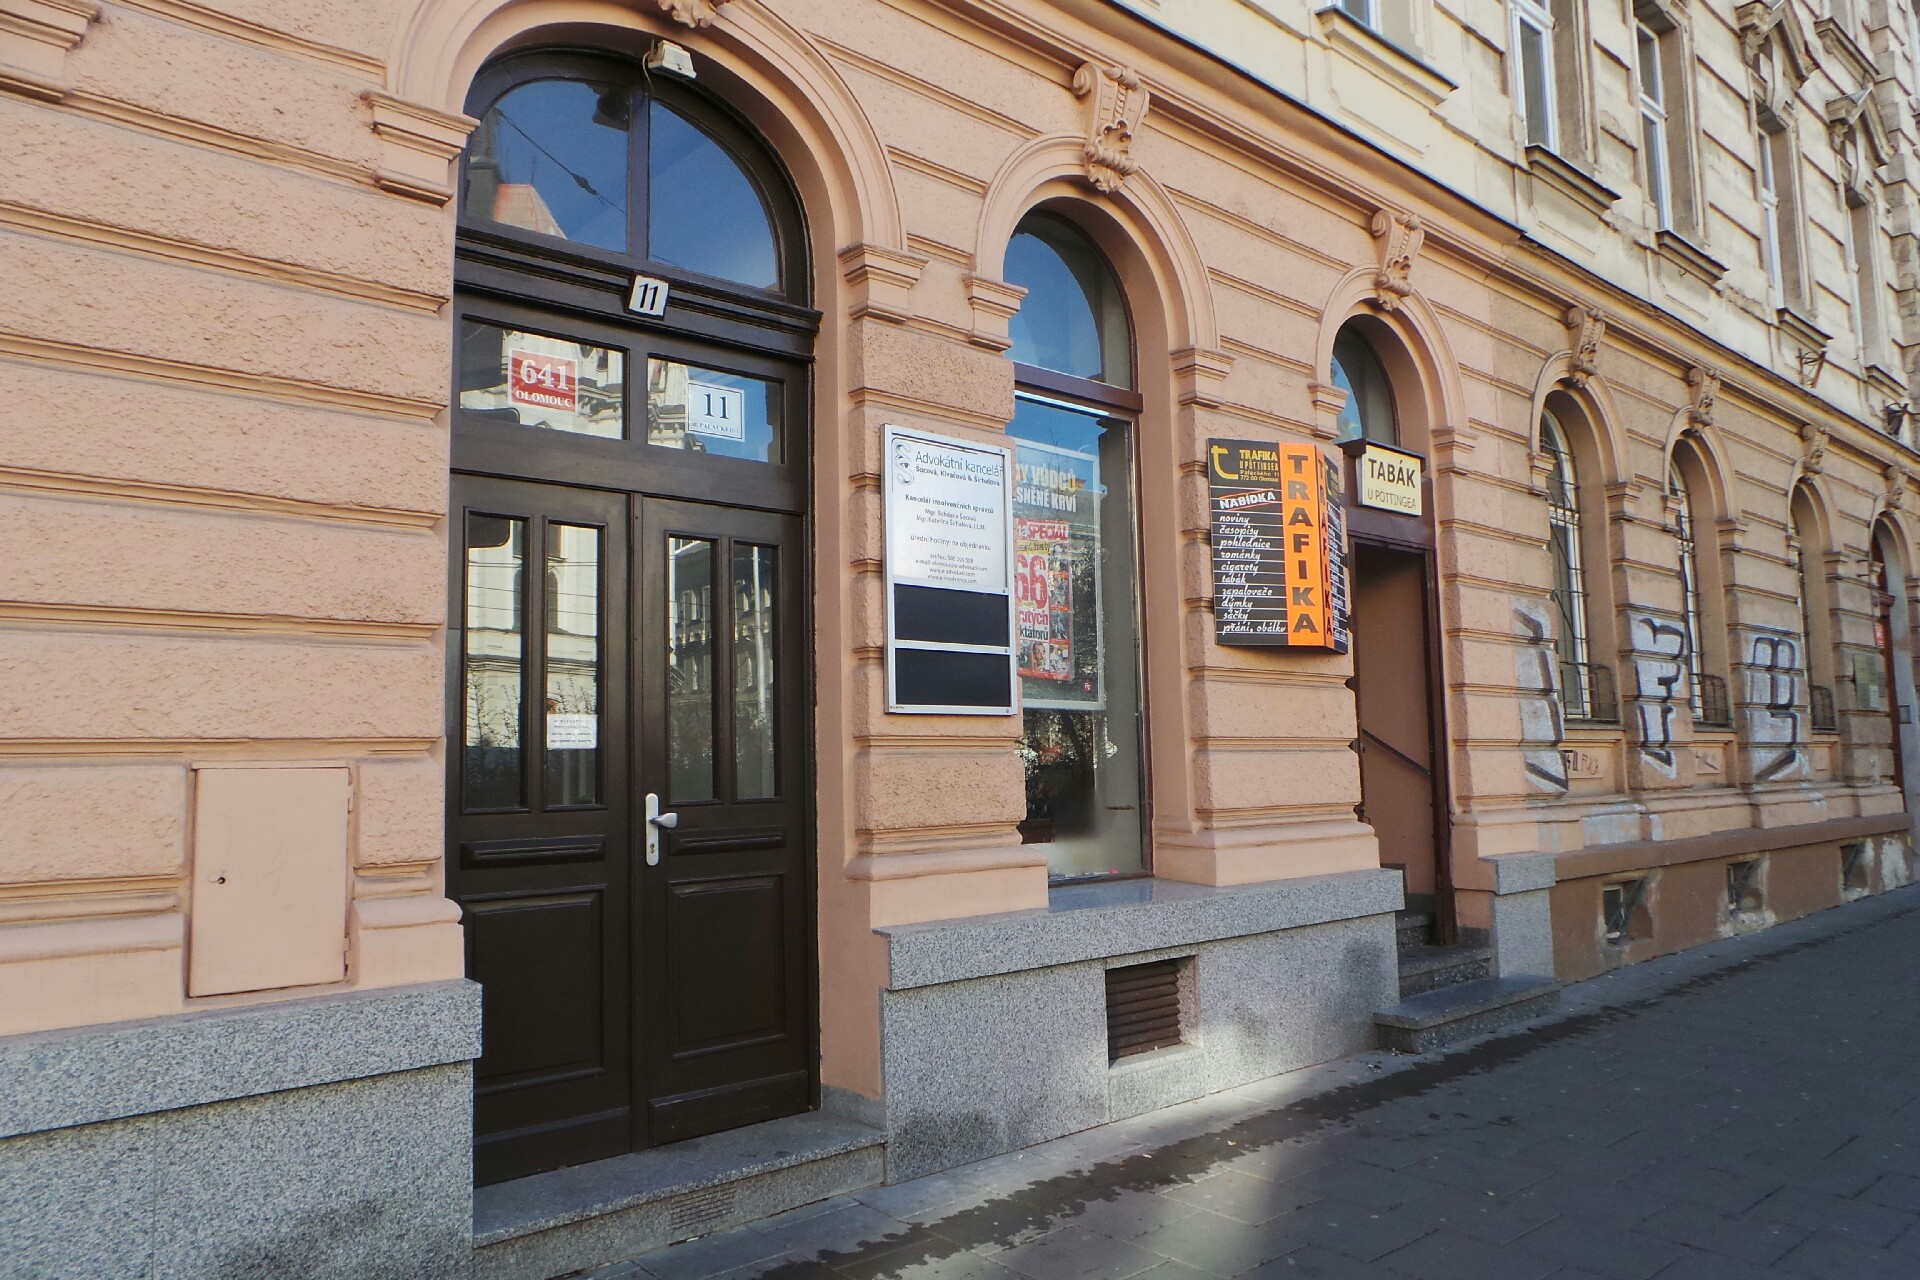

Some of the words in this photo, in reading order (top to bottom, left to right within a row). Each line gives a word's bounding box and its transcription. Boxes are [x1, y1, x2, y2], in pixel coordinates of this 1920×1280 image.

[639, 283, 659, 311] 11
[520, 359, 569, 390] 641
[515, 390, 573, 407] OLOMOUC
[703, 392, 729, 420] 11
[1239, 449, 1278, 461] TRAFIKA
[915, 450, 963, 471] Advokátní
[965, 459, 1004, 478] kancelář
[1030, 462, 1076, 492] VŮDCŮ
[1367, 457, 1416, 489] TABÁK
[932, 497, 972, 511] insolvenčních
[1013, 485, 1050, 508] SNĚNÉ
[1051, 494, 1077, 513] KRVÍ
[1219, 491, 1276, 510] NABÍDKA
[1367, 488, 1374, 500] U
[1375, 488, 1417, 510] PÖTTINGEA
[1219, 512, 1250, 528] noviny
[1219, 524, 1259, 540] časopisy
[1219, 535, 1271, 551] pohlednice
[1287, 454, 1319, 634] TRAFIKA
[1318, 458, 1333, 637] TRAFIKA
[1220, 548, 1261, 564] románky
[1221, 560, 1259, 576] cigarety
[1221, 572, 1247, 583] tabák
[1222, 584, 1273, 600] zapalovače
[1221, 595, 1254, 612] dýmky
[1019, 608, 1049, 626] rutých
[1222, 608, 1249, 624] sáčky
[1019, 625, 1049, 641] ktátorů
